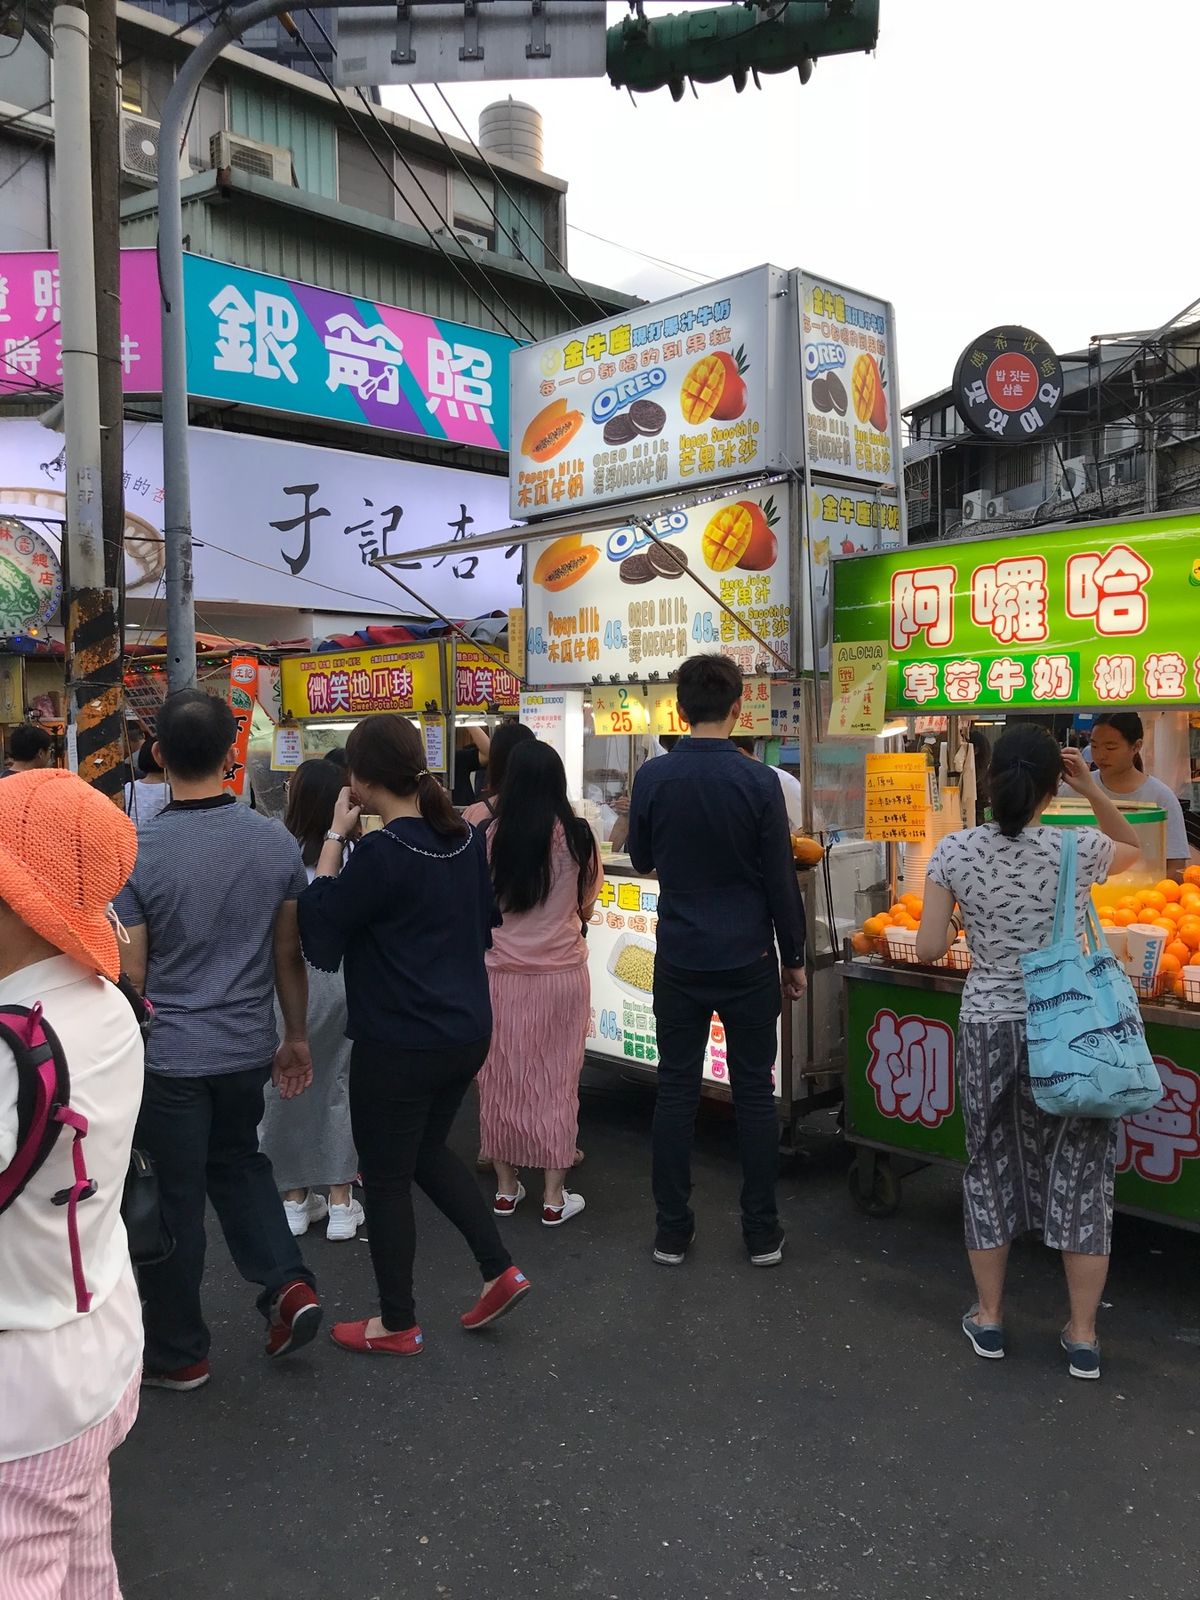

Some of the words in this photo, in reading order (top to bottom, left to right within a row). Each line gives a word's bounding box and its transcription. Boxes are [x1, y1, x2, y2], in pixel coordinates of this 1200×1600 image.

[564, 324, 631, 370] 金牛座
[804, 342, 846, 372] OREO
[540, 327, 732, 397] 每一口都喝的到果粒
[996, 370, 1006, 382] 밥
[1010, 371, 1030, 382] 짓는
[592, 367, 666, 423] OREO
[1003, 384, 1023, 396] 삼촌
[964, 380, 1060, 436] 맛있어요
[711, 422, 759, 442] Smoothie
[593, 448, 627, 468] OREO
[633, 439, 669, 459] Milk
[679, 438, 758, 477] 芒果冰沙
[519, 468, 555, 485] Papaya
[559, 458, 585, 477] Milk
[518, 474, 584, 507] 木瓜牛奶
[269, 484, 523, 585] 于記杏
[747, 574, 770, 587] Juice
[720, 586, 770, 607] 芒果汁
[890, 545, 1152, 650] 阿囉哈
[548, 611, 576, 637] Papaya
[579, 606, 599, 634] Milk
[628, 600, 655, 628] OREO
[659, 596, 687, 625] Milk
[748, 604, 791, 620] Smoothie
[720, 618, 790, 642] 芒果冰沙
[548, 636, 599, 663] 木瓜牛奶
[838, 646, 882, 661] ALOHA
[309, 671, 412, 713] 微笑地瓜球
[903, 655, 1073, 703] 草莓牛奶
[1093, 652, 1200, 701] 柳橙
[351, 700, 373, 712] Sweet
[374, 698, 399, 710] Potato
[400, 695, 412, 709] Ball
[618, 688, 629, 709] 2
[611, 711, 632, 732] 25
[779, 723, 788, 732] 70
[588, 911, 657, 934] 口都喝
[1141, 938, 1157, 988] ALOHA
[866, 1008, 955, 1128] 柳
